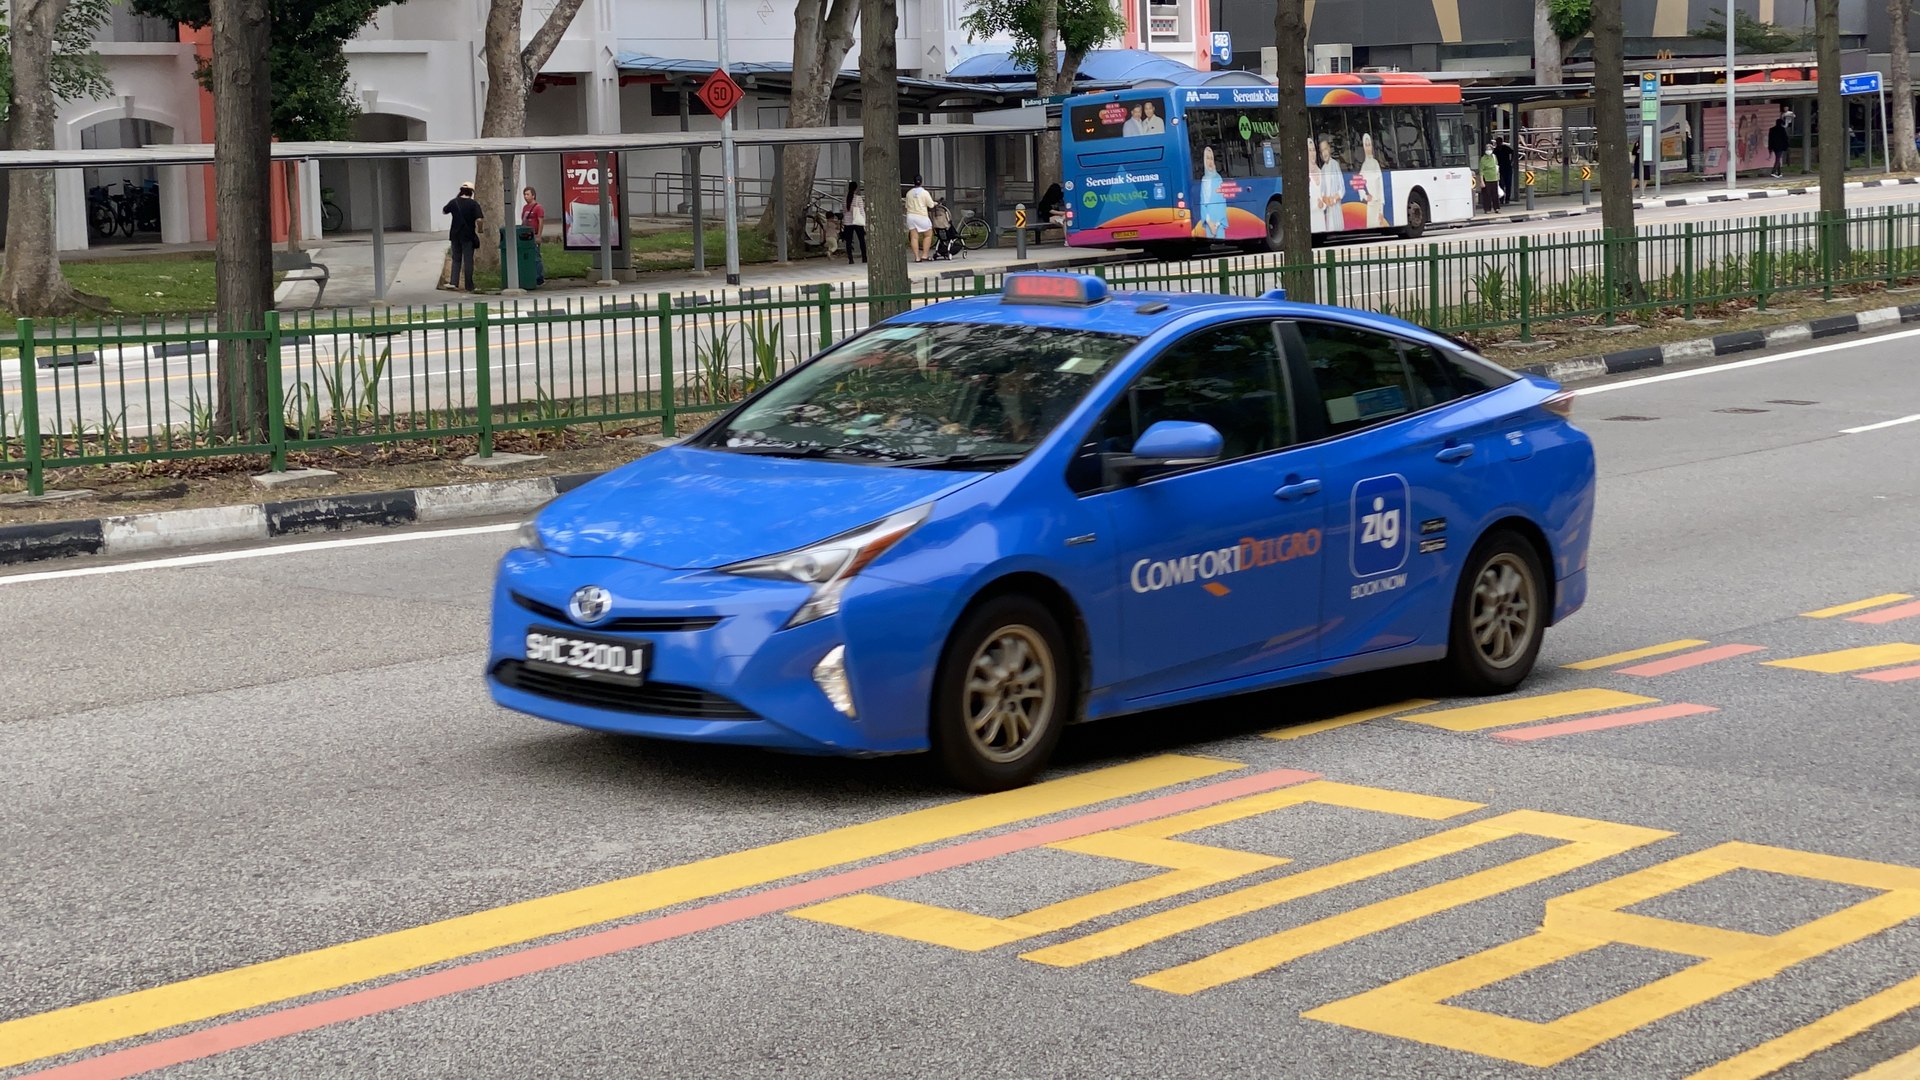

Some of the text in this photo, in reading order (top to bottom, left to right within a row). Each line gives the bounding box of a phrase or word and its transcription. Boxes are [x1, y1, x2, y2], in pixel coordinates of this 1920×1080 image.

[713, 86, 727, 101] 50
[1233, 89, 1265, 103] Serentak
[1086, 173, 1160, 187] Serentak Semasa
[1361, 496, 1400, 549] zig
